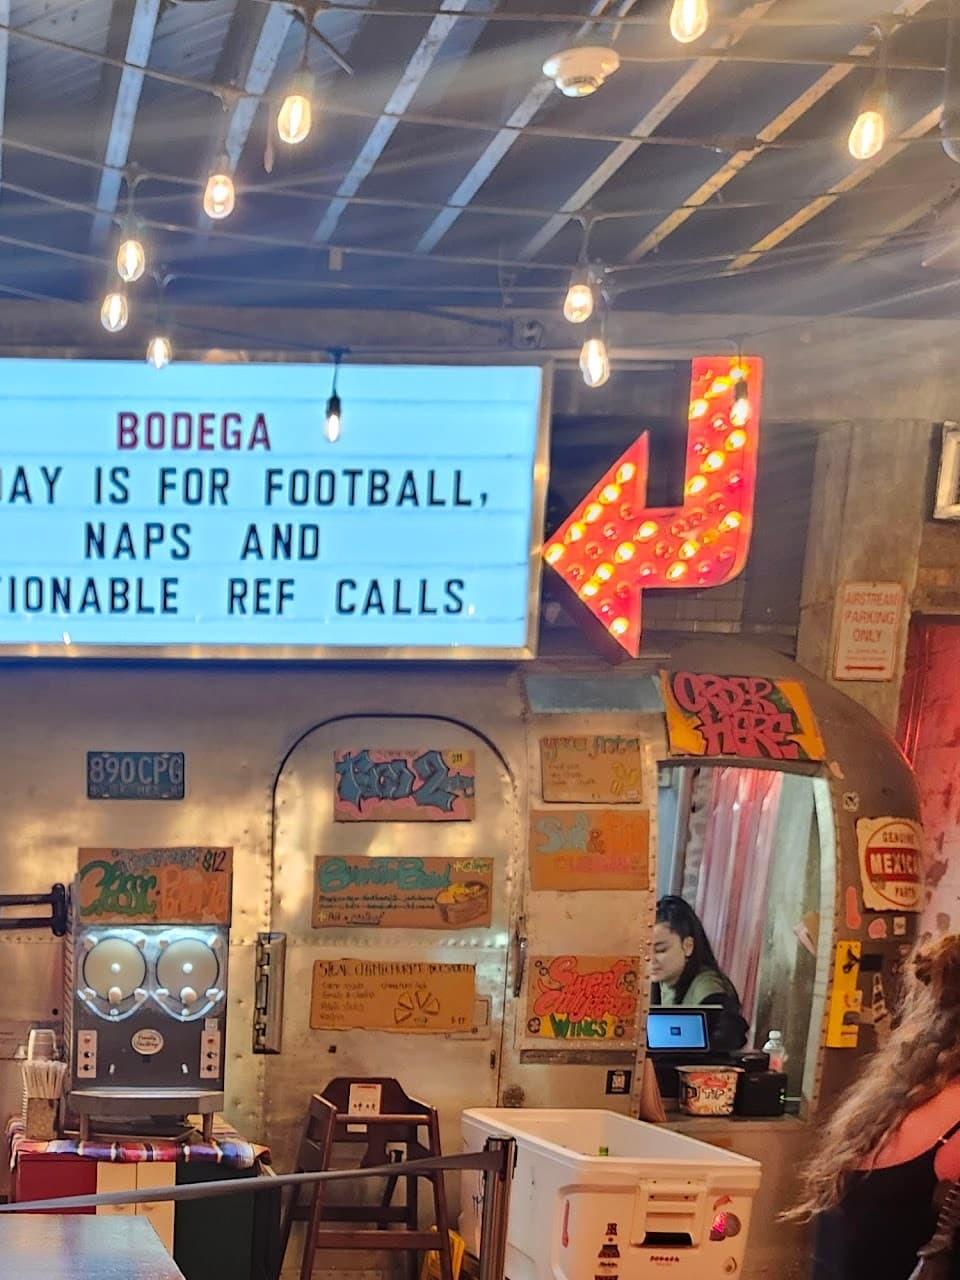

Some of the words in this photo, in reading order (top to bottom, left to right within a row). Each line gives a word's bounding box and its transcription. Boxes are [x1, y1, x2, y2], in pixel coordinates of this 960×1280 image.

[116, 412, 272, 451] BODEGA
[95, 466, 131, 505] IS
[159, 467, 229, 506] FOR
[265, 468, 489, 507] FOOTBALL,
[84, 522, 192, 561] NAPS
[240, 523, 320, 561] AND
[228, 578, 295, 615] REF
[335, 578, 465, 615] CALLS
[845, 611, 896, 624] PARKING
[853, 629, 882, 642] ONLY
[698, 711, 799, 759] HERE
